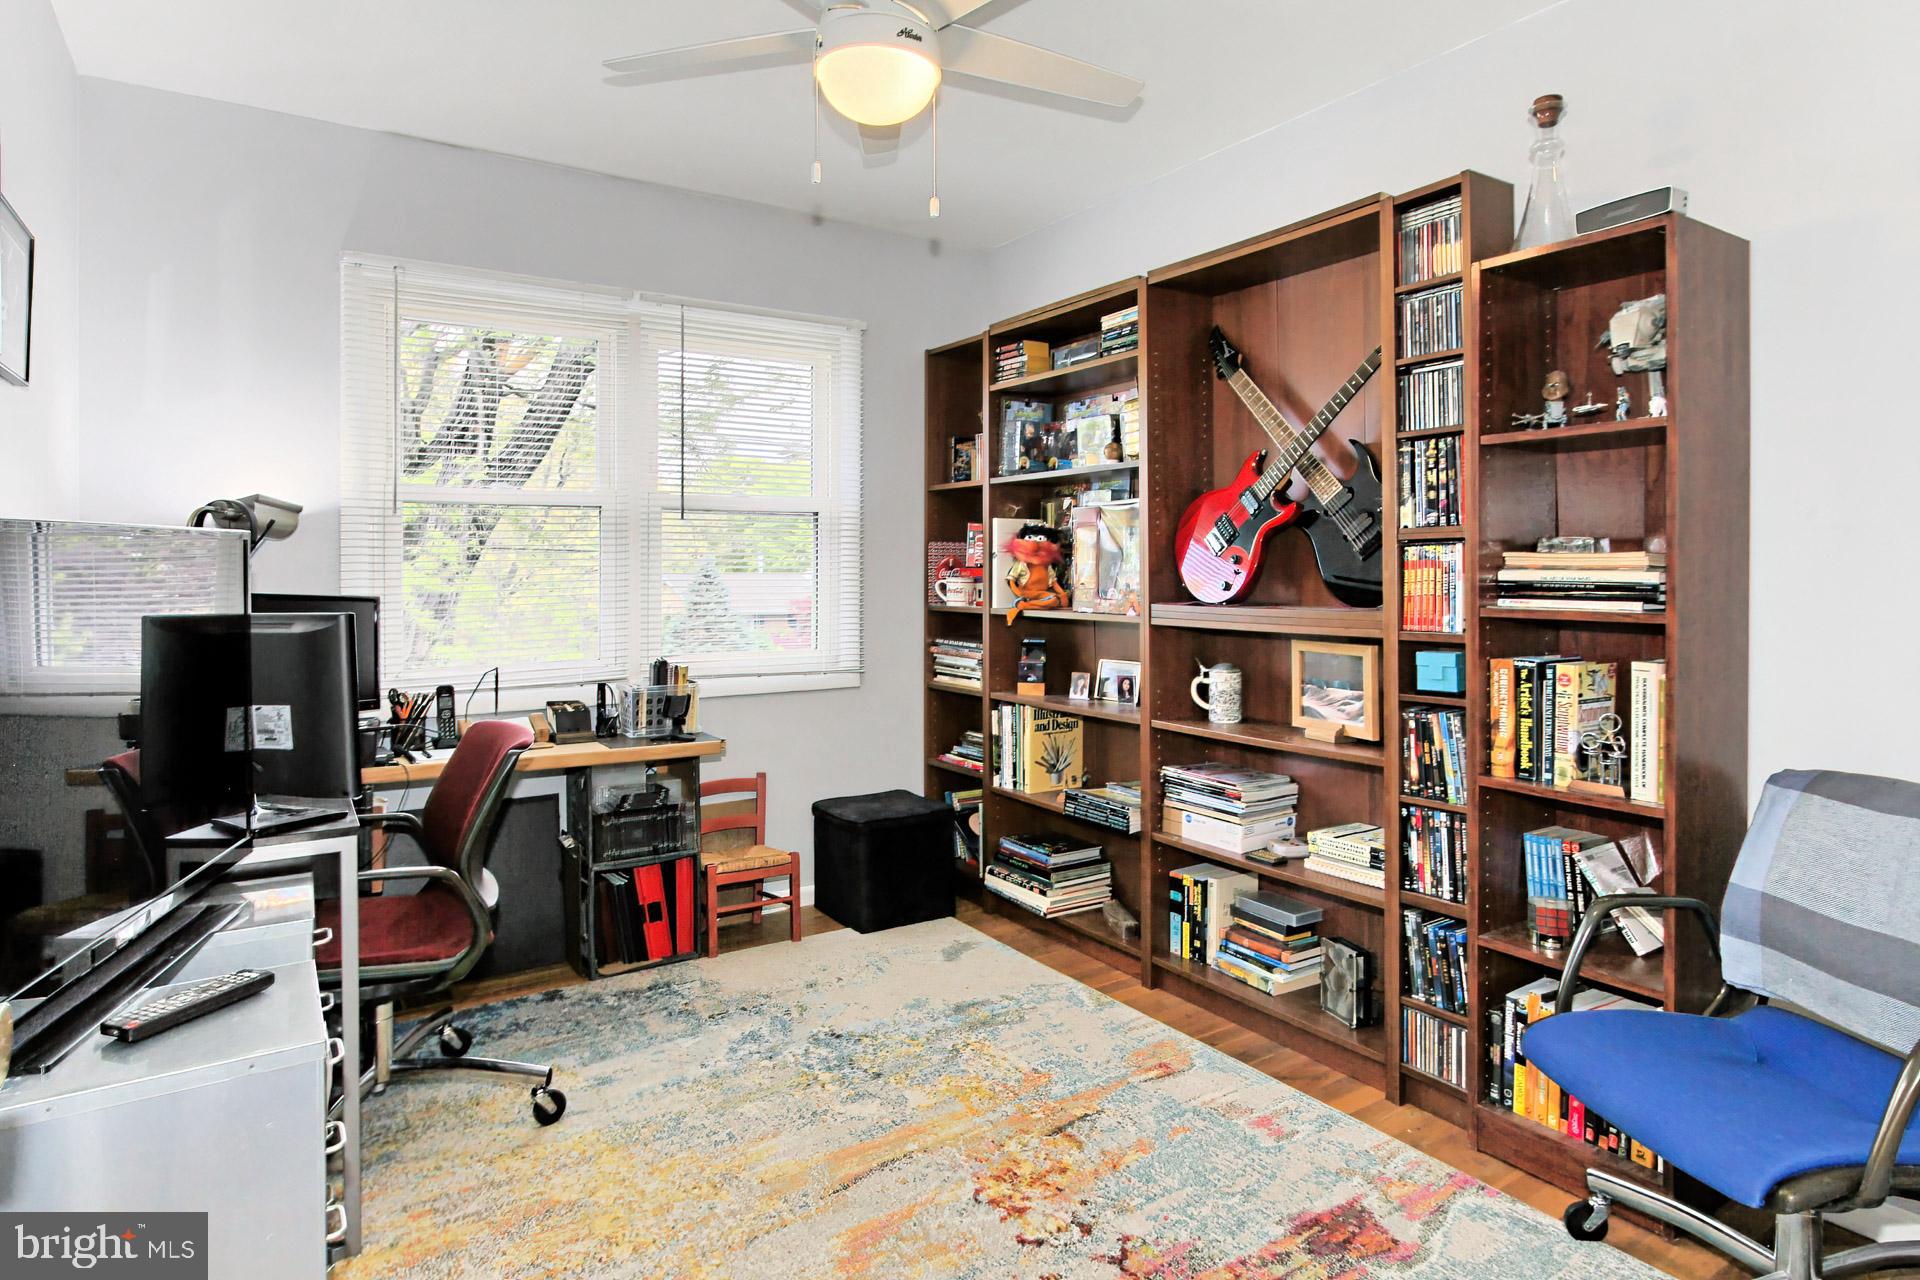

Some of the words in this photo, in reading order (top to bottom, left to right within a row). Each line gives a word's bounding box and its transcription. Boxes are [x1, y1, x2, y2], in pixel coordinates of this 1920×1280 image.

[1520, 681, 1533, 715] Artist's
[1034, 720, 1050, 732] and
[1051, 719, 1079, 732] Design
[1520, 718, 1534, 769] Handbook
